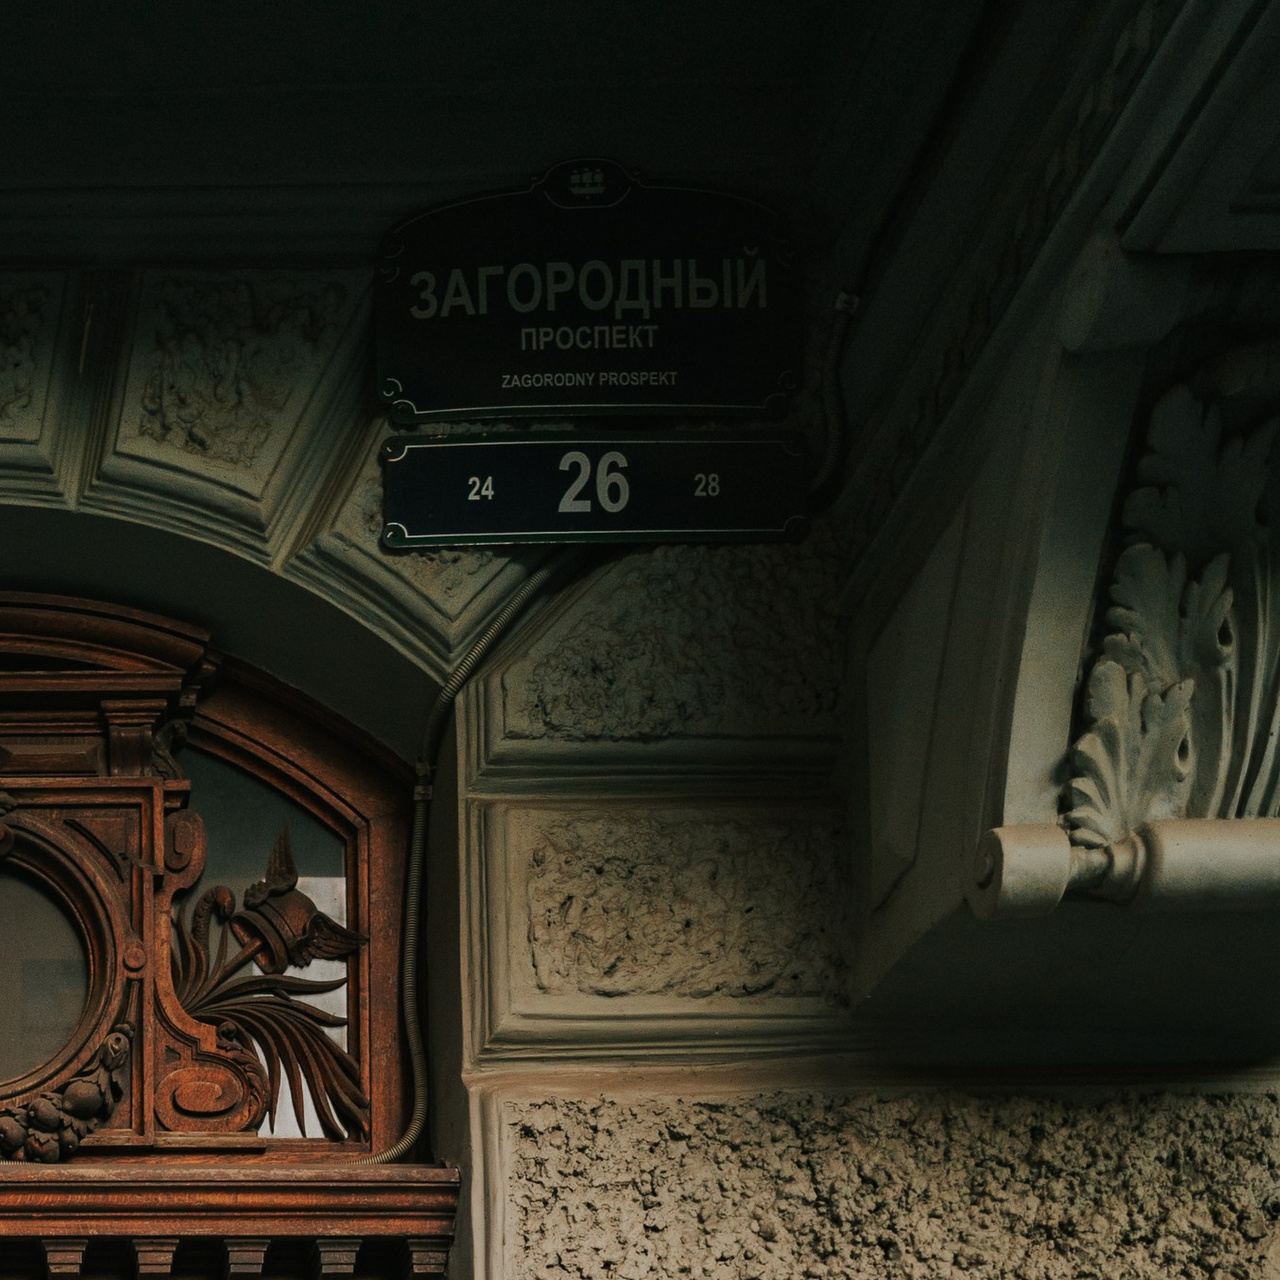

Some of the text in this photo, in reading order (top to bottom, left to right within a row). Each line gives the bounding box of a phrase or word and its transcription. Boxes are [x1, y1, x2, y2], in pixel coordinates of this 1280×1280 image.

[409, 245, 768, 321] ЗАГОРОДНЫЙ
[520, 324, 659, 351] ПРОСПЕКТ
[501, 371, 678, 389] ZAGORODNY PROSPEKT
[467, 450, 720, 513] 24 26 28
